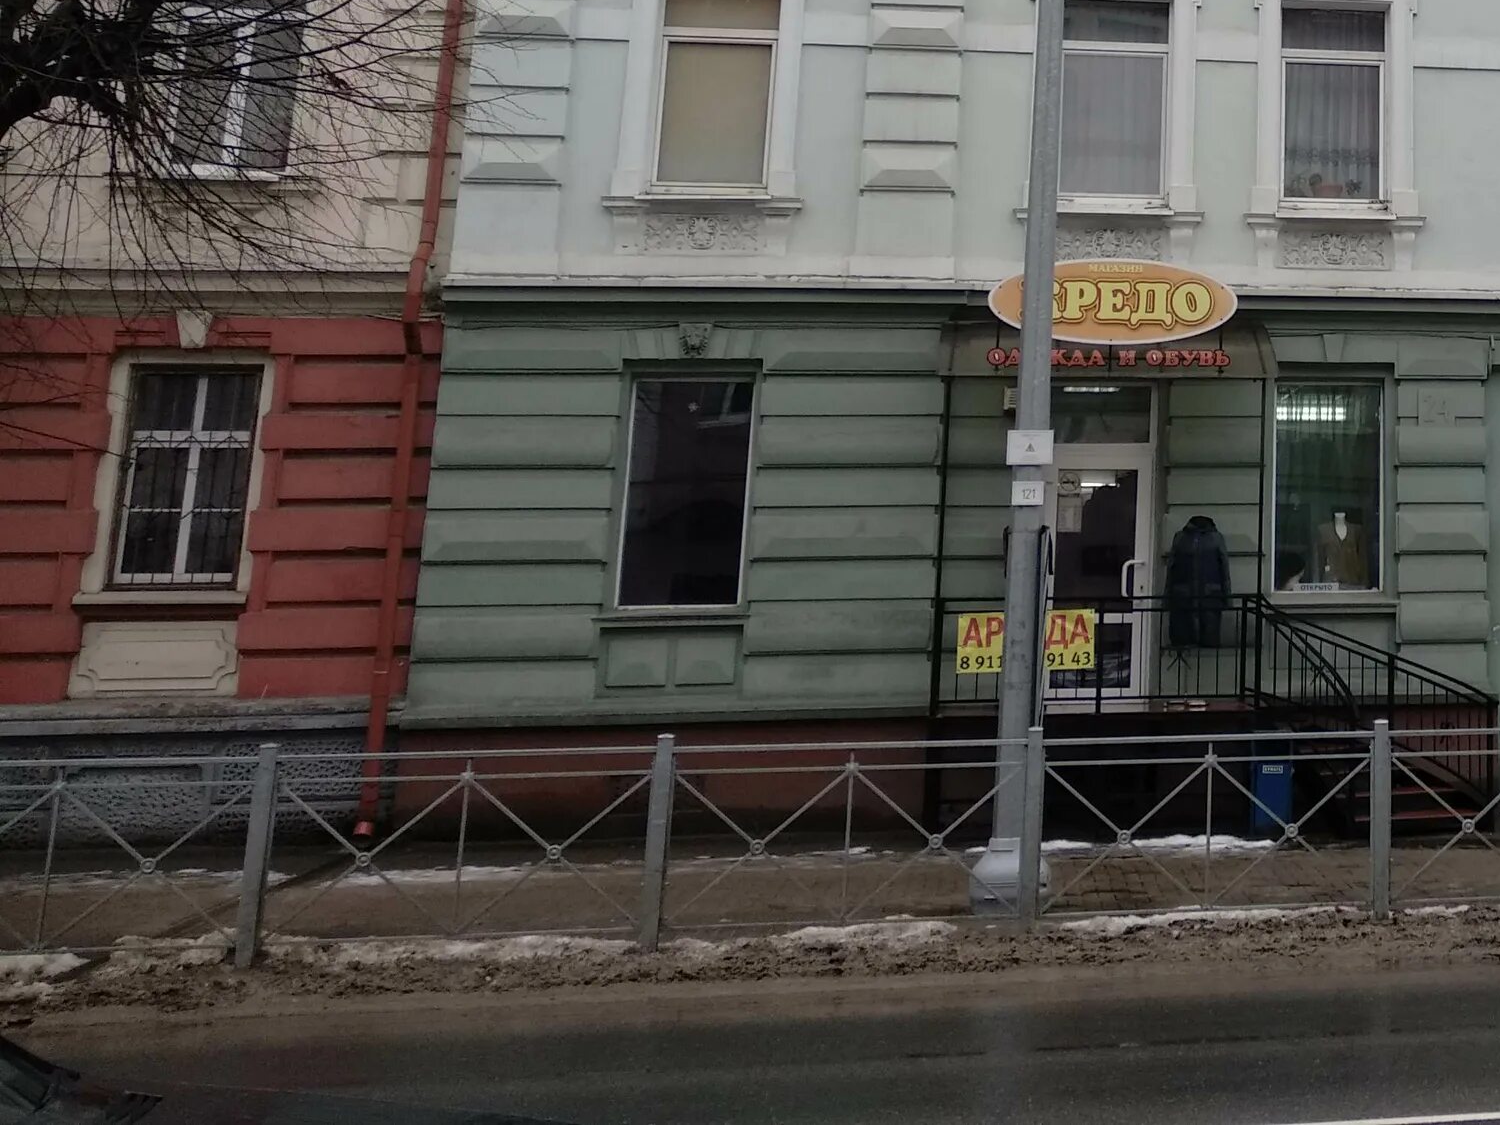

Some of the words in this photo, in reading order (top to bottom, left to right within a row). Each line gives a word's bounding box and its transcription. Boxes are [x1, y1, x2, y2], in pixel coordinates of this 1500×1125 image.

[1088, 263, 1143, 274] МАГАЗИН
[987, 348, 1106, 367] ОДЖДА
[1119, 349, 1137, 367] И
[1146, 348, 1231, 367] ОБУВЬ
[1022, 489, 1036, 500] 121
[961, 614, 1091, 650] АРДА
[960, 656, 970, 669] 8
[1072, 651, 1091, 665] 43
